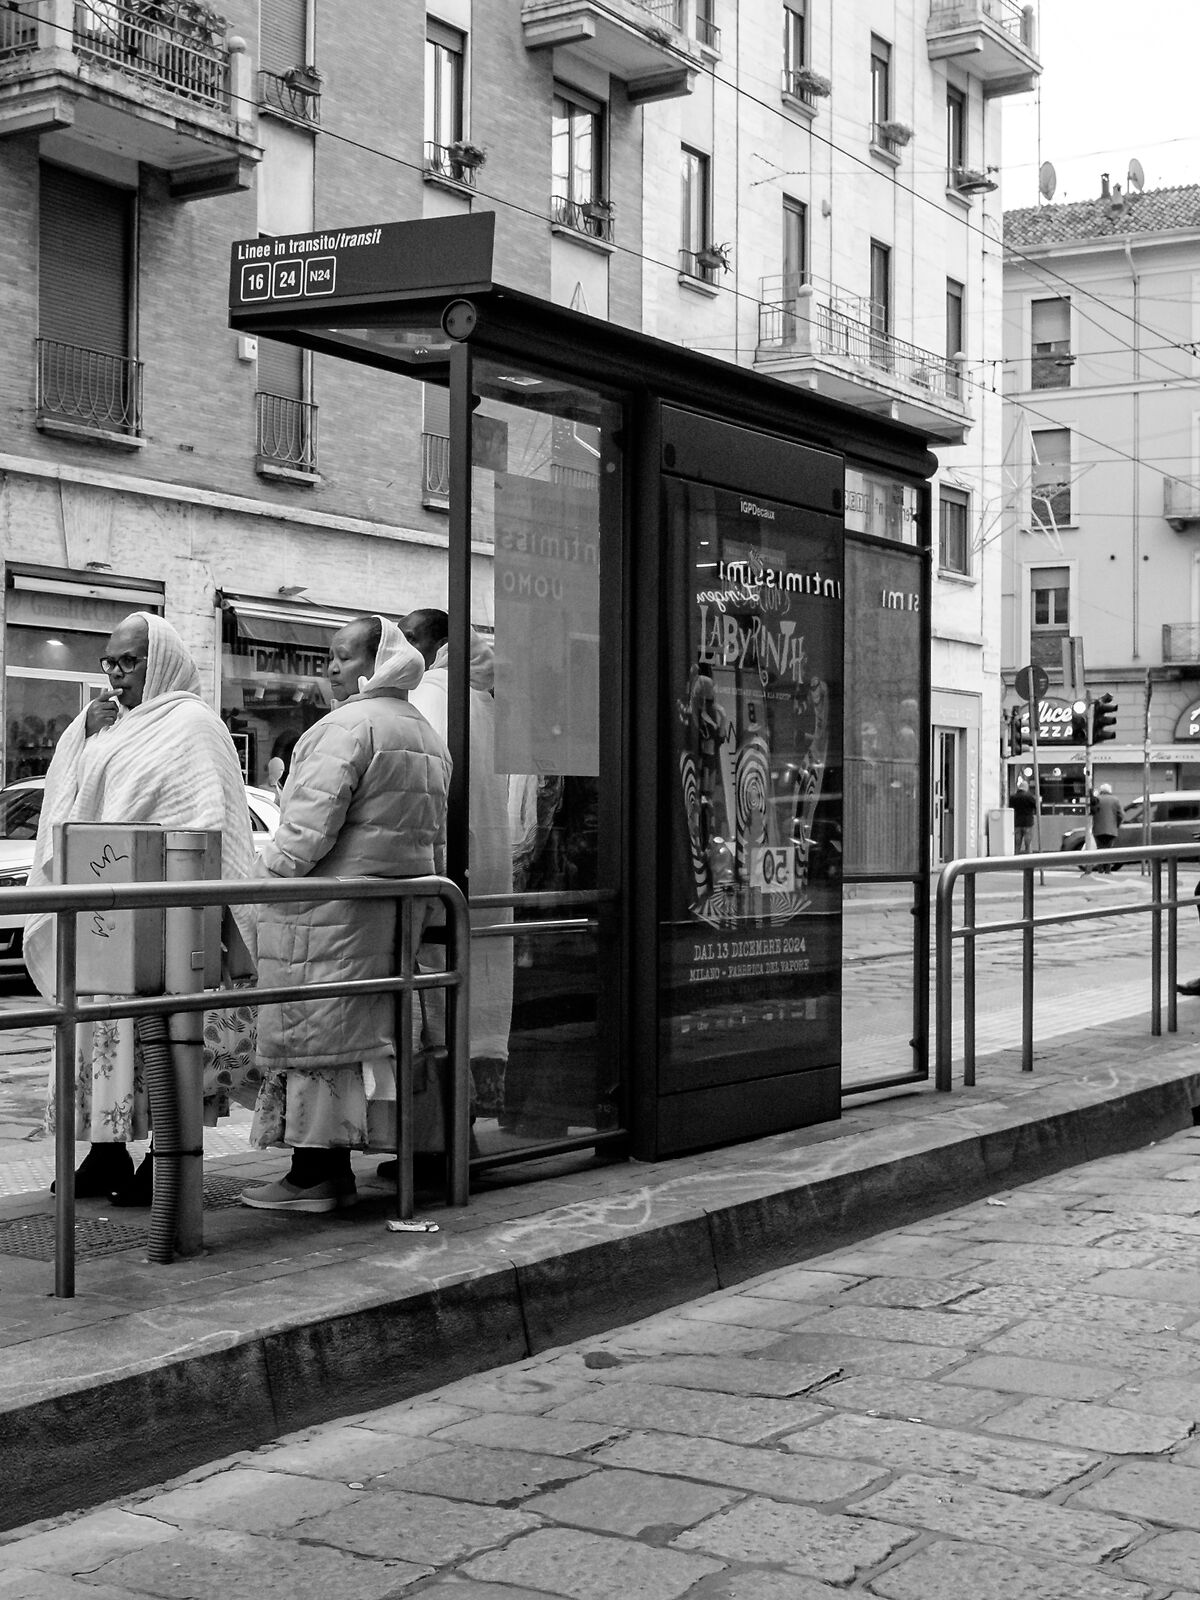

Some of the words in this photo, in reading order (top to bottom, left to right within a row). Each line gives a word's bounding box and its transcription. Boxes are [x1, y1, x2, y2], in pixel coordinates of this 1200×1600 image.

[238, 244, 271, 260] Linee
[274, 241, 286, 257] in
[289, 229, 382, 254] transito/transit
[248, 273, 264, 291] 16
[279, 271, 296, 288] 24
[309, 269, 331, 283] N24
[699, 605, 804, 687] LABYRINTH
[1021, 726, 1073, 738] PZZA
[693, 943, 715, 961] DAL
[717, 942, 729, 959] 13
[731, 939, 782, 958] DICEMBRE
[783, 937, 806, 953] 2024
[689, 967, 720, 982] MILANO
[727, 964, 764, 978] FABBRICA
[765, 961, 779, 974] DEL
[780, 959, 810, 972] VAPORE
